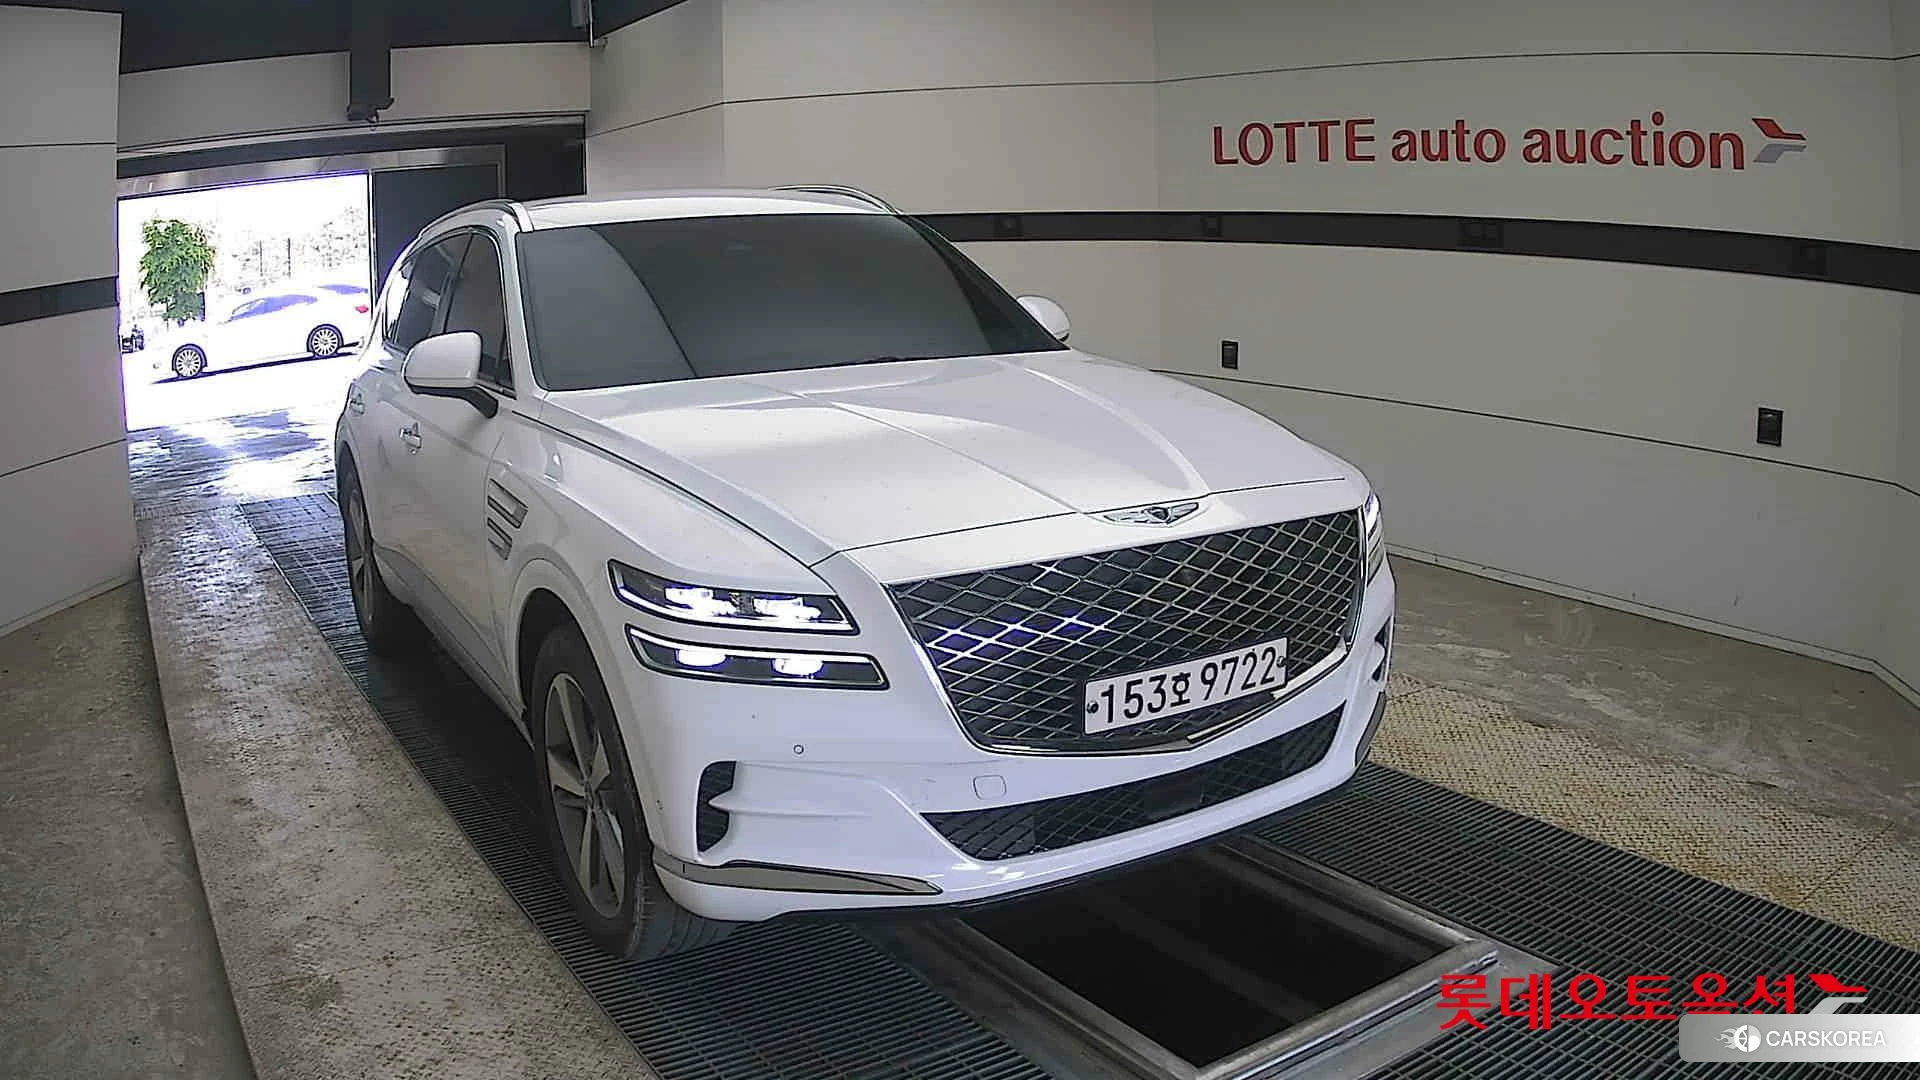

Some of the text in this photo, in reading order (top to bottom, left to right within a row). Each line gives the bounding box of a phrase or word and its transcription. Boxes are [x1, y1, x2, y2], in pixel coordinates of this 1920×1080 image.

[1213, 111, 1745, 170] LOTTE auto auction
[1101, 646, 1277, 723] 153호 9722
